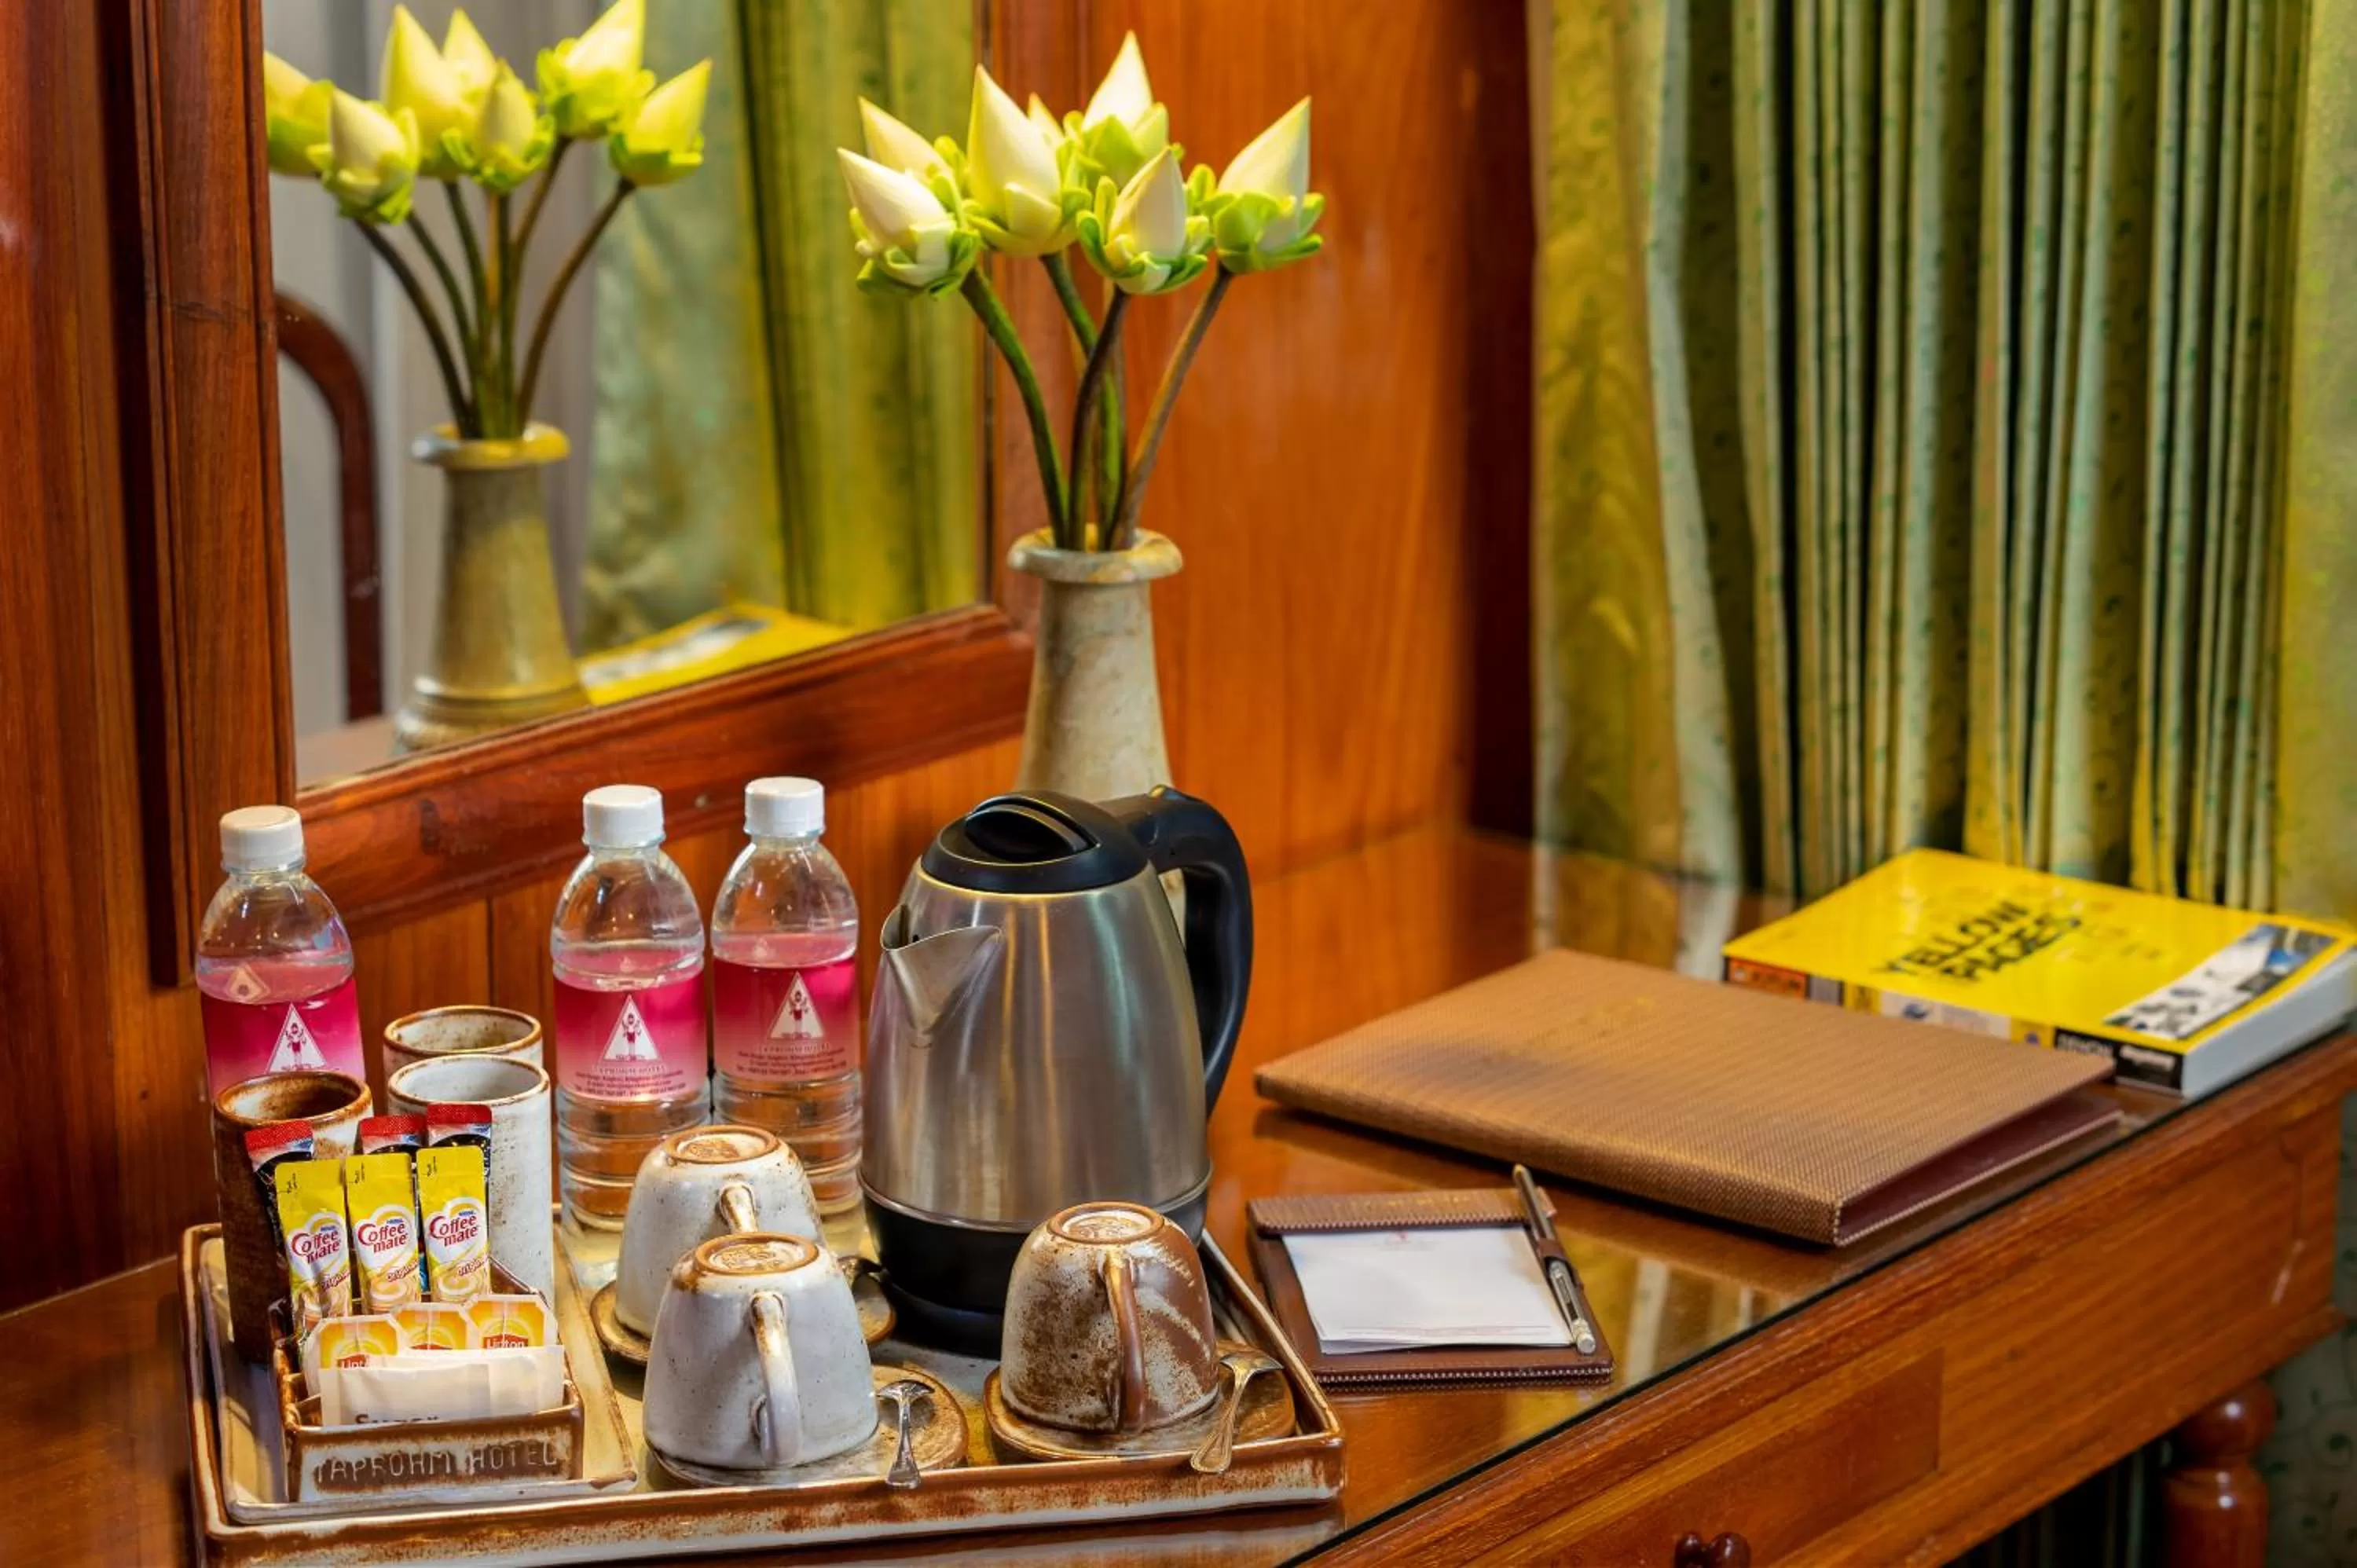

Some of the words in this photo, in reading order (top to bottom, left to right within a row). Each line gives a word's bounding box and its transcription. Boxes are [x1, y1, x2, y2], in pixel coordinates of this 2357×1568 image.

[357, 1223, 405, 1246] Coffee
[429, 1215, 477, 1239] Coffee
[444, 1226, 478, 1247] mate
[291, 1231, 339, 1256] Coffee
[306, 1242, 340, 1264] mate
[373, 1234, 407, 1253] mate
[467, 1441, 558, 1475] HOTEL
